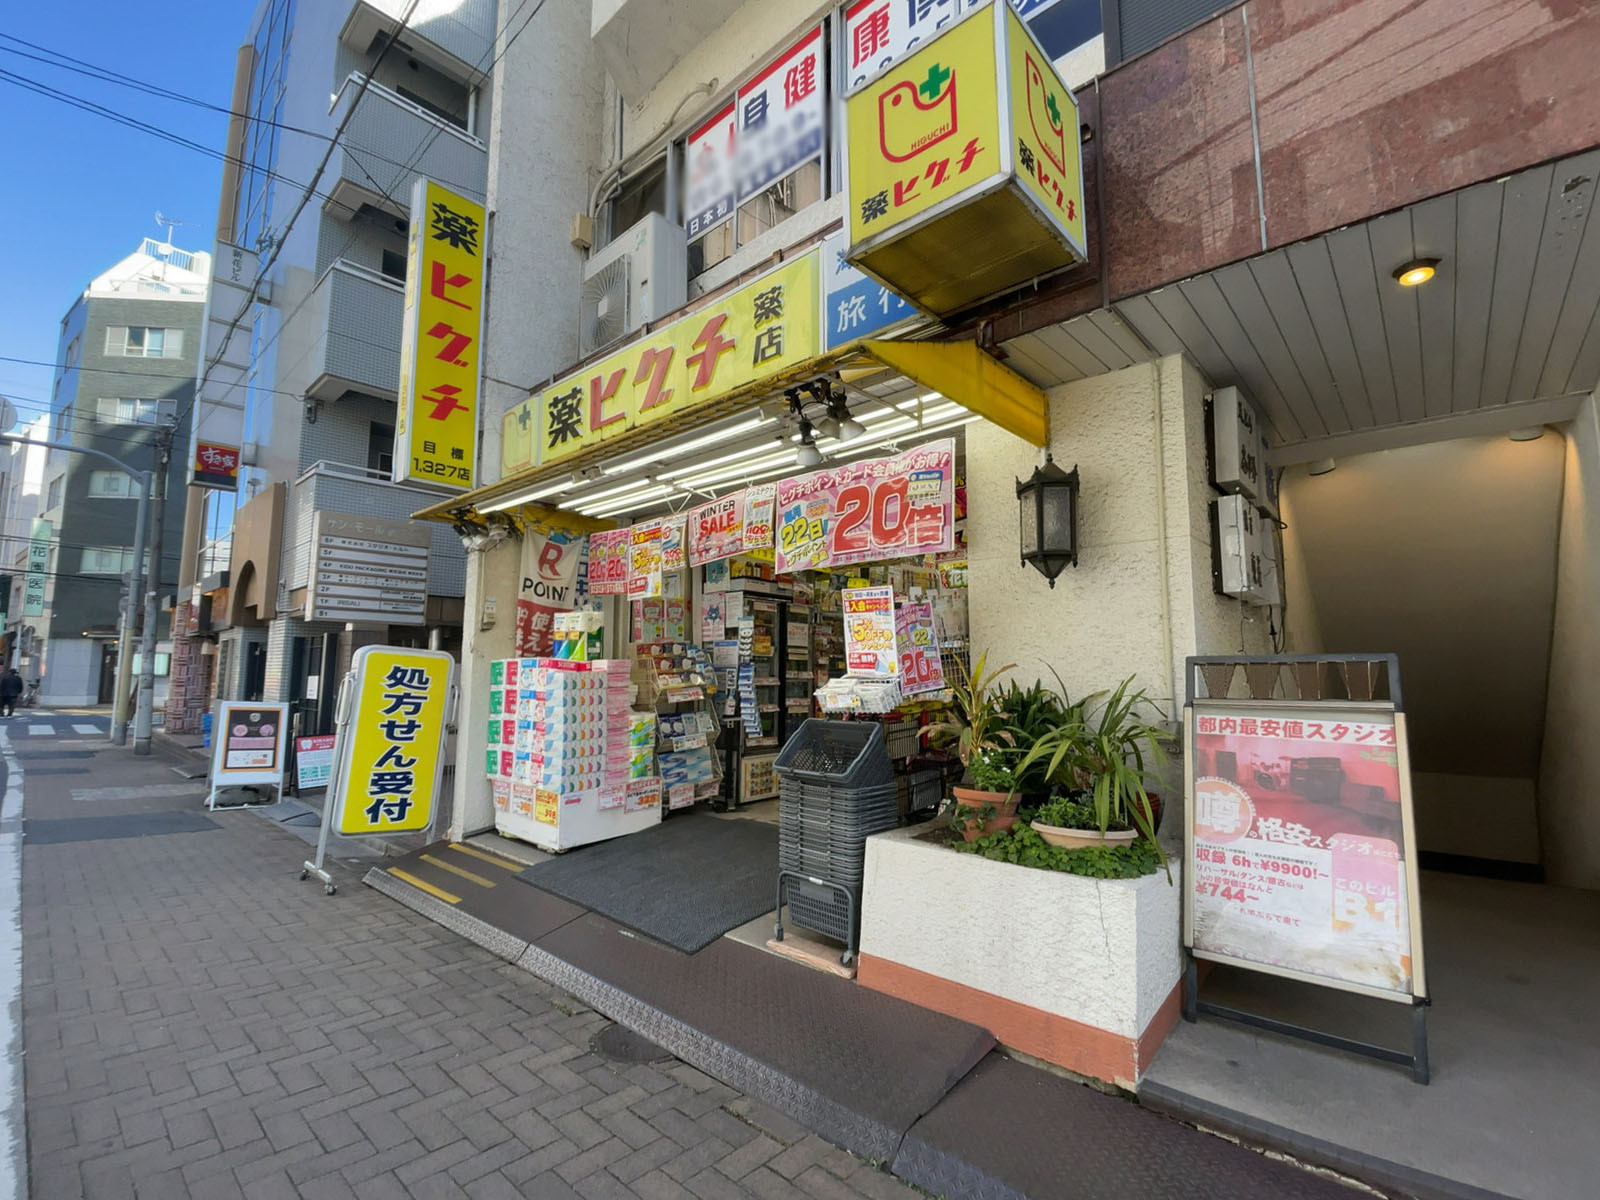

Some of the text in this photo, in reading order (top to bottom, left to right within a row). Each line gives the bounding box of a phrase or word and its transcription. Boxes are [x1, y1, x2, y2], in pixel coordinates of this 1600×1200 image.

[910, 122, 950, 150] HIGUCHI
[421, 202, 479, 422] 薬ヒグチ
[753, 284, 786, 367] 薬店
[700, 500, 736, 521] WINTER
[700, 510, 736, 538] SALE
[834, 476, 944, 556] 20倍
[781, 516, 824, 556] 22日
[320, 585, 330, 593] 2F
[365, 665, 430, 824] 処方せん受付
[1199, 716, 1396, 745] 都内最安値スタジオ
[1196, 847, 1227, 865] 収録
